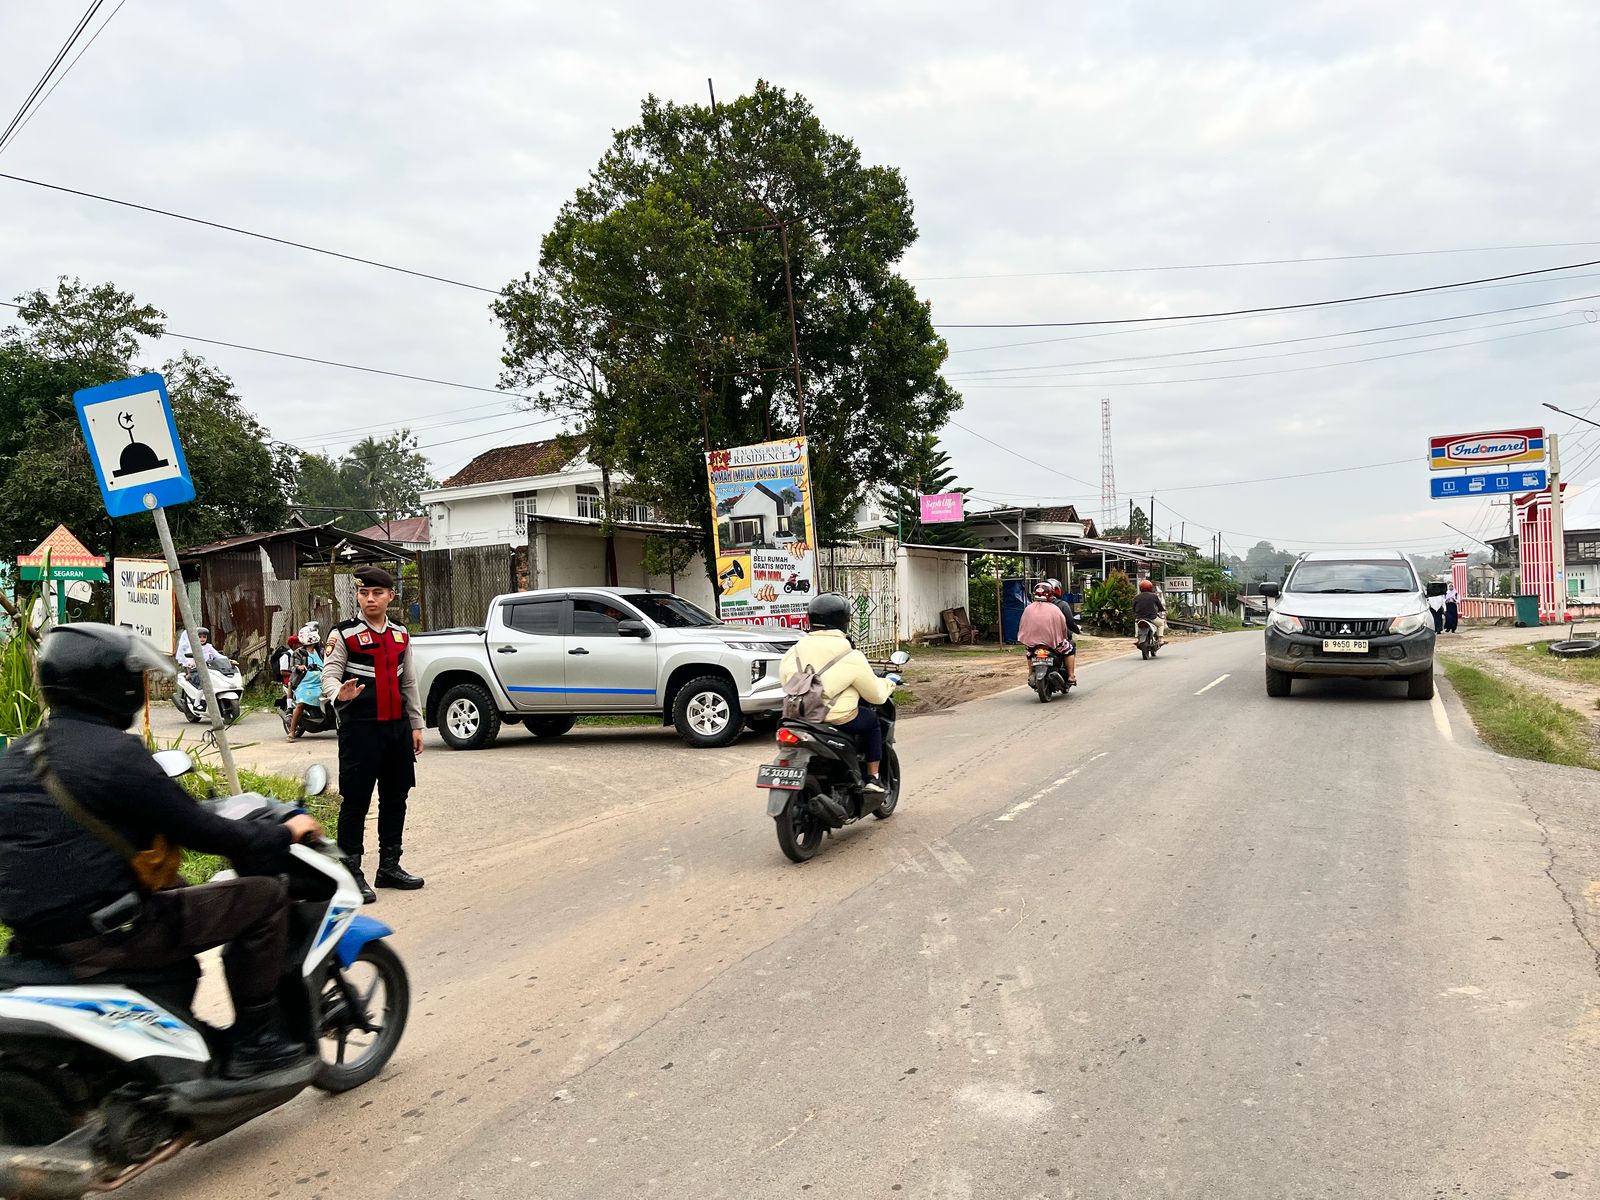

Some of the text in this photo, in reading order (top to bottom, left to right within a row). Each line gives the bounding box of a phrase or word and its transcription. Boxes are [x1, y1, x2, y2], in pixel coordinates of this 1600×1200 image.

[1452, 441, 1525, 456] Indomaret
[733, 451, 788, 464] RESIDENCE
[711, 463, 804, 483] RUMAH IMPIAN LOKASI TERBAIK
[121, 570, 135, 588] SMK
[136, 571, 163, 590] NEGERI
[128, 591, 160, 605] TALANG UBI
[1324, 640, 1329, 648] B
[1332, 640, 1350, 648] 9650
